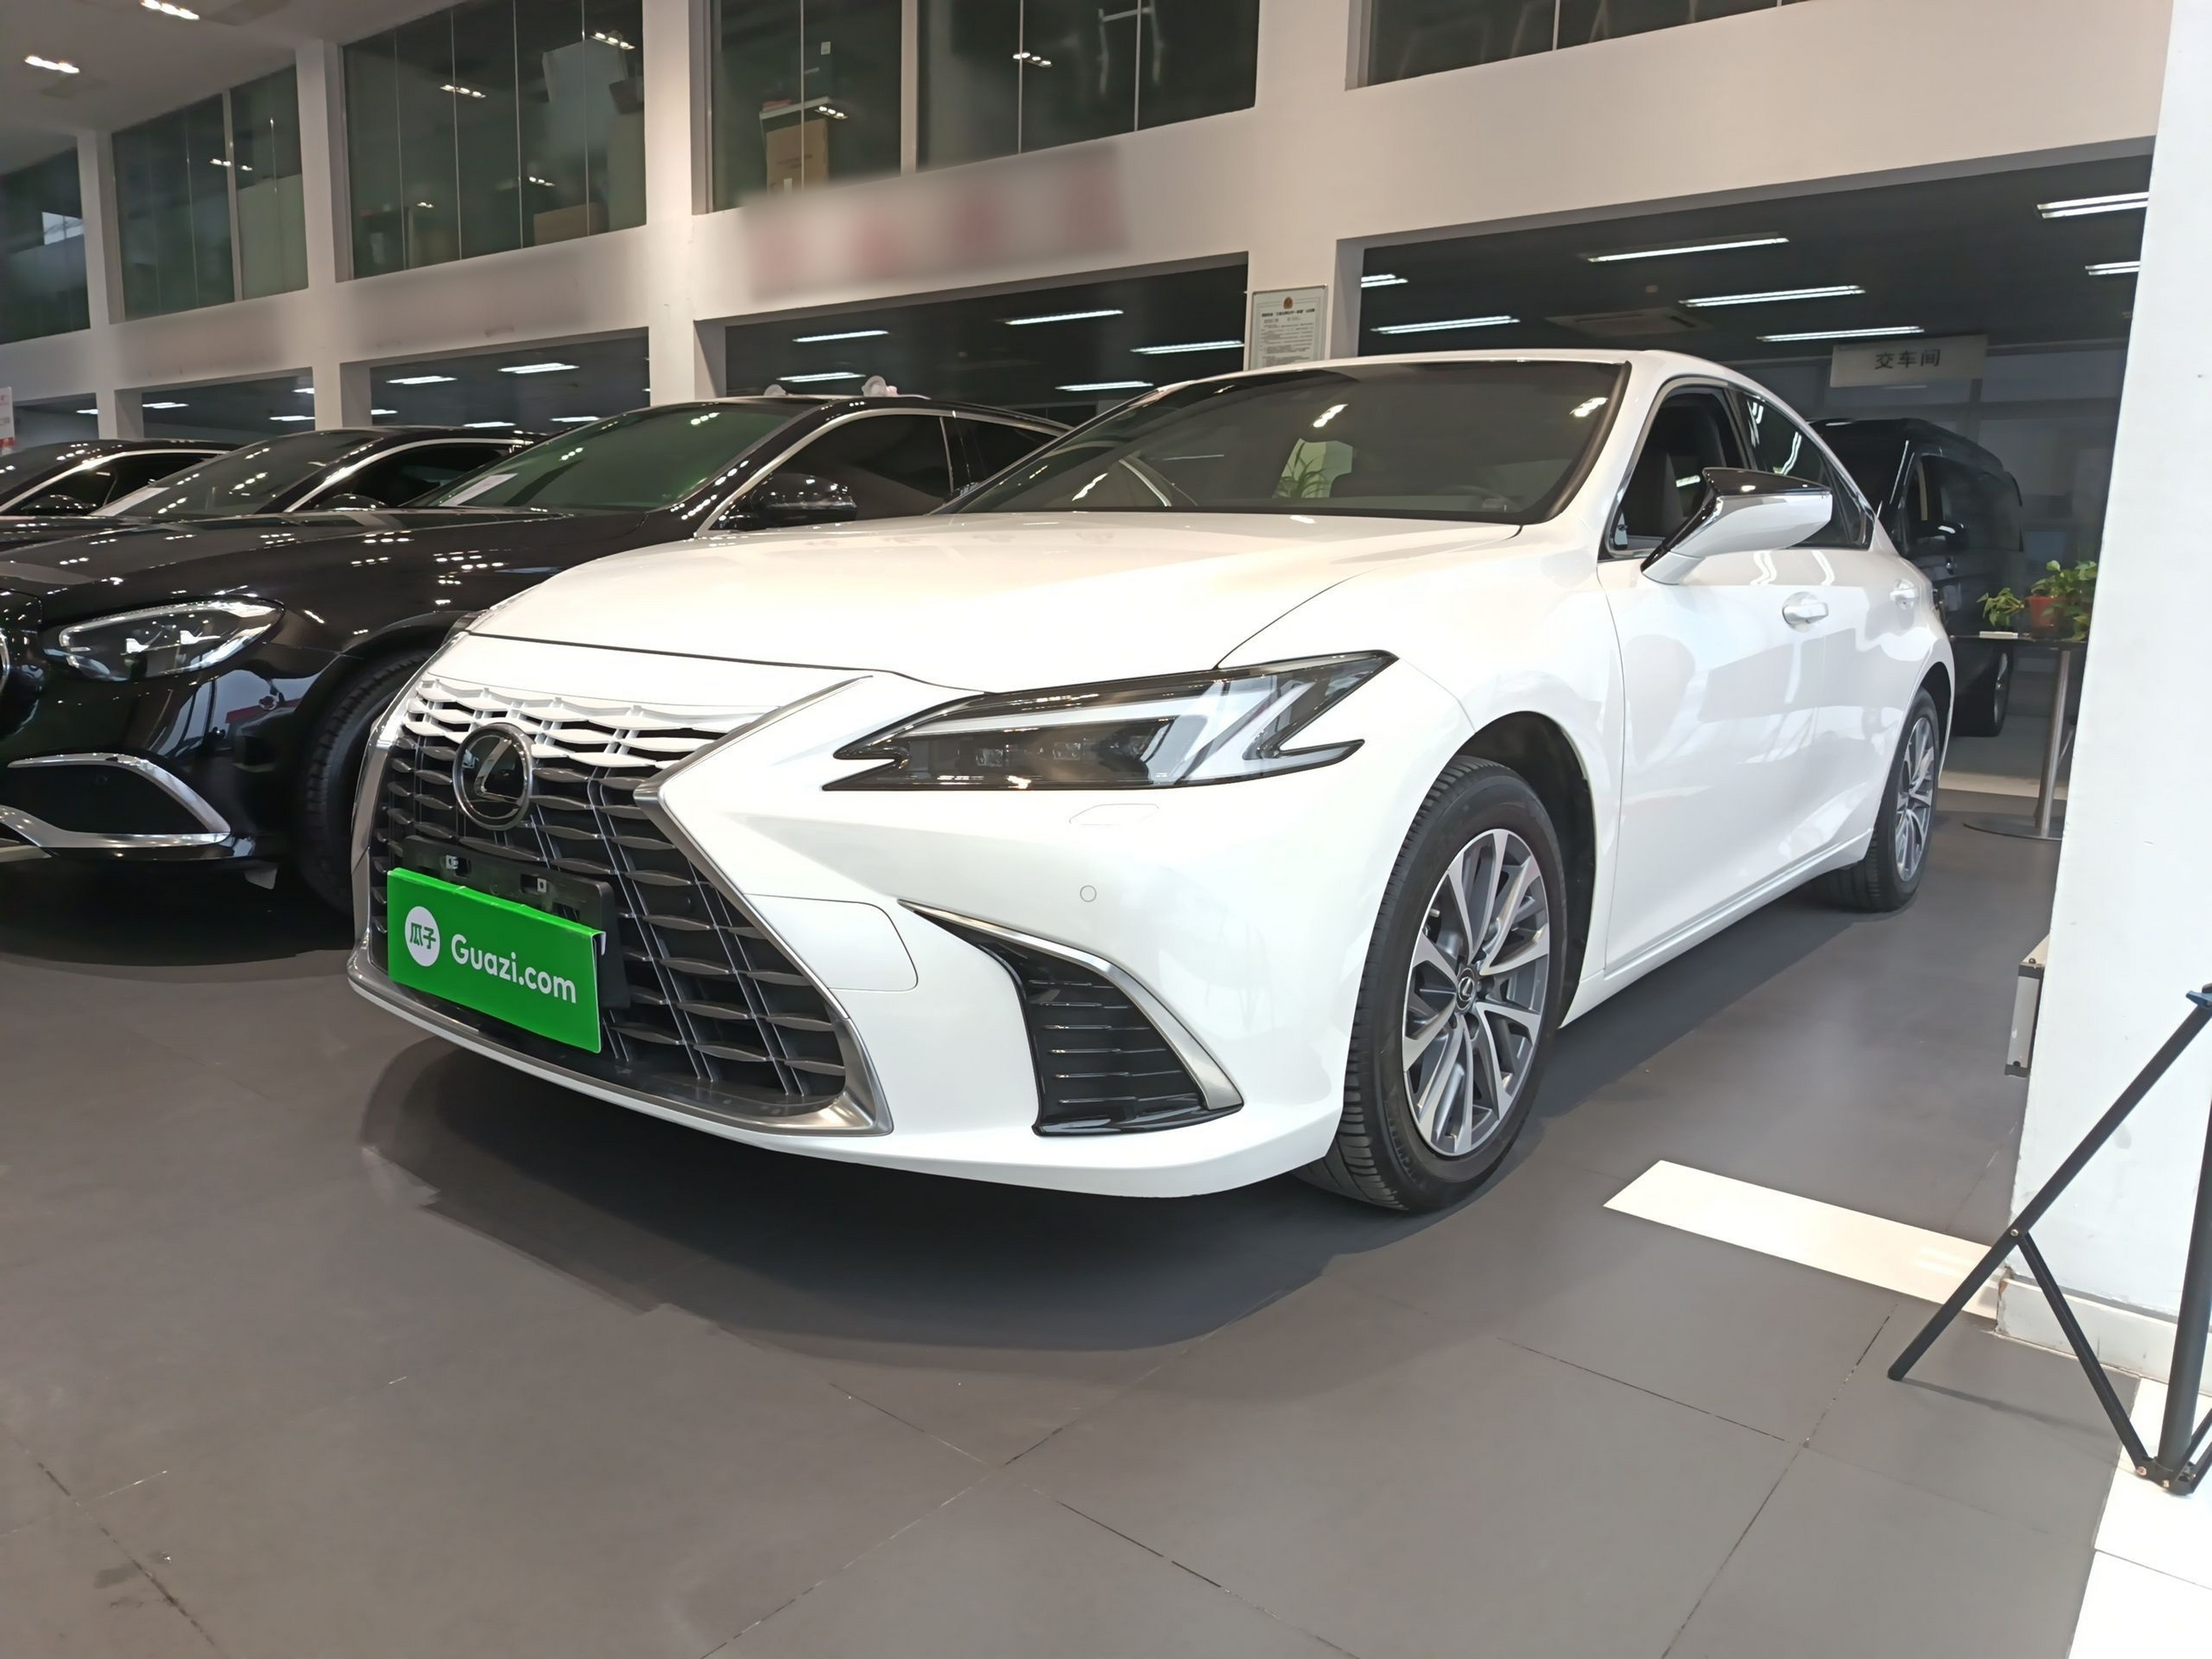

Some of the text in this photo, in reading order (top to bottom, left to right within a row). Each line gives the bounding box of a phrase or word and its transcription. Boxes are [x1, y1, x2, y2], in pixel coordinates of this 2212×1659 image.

[1874, 349, 1941, 370] 交车间
[410, 922, 436, 949] 瓜子
[451, 933, 576, 1003] Guazi.com
